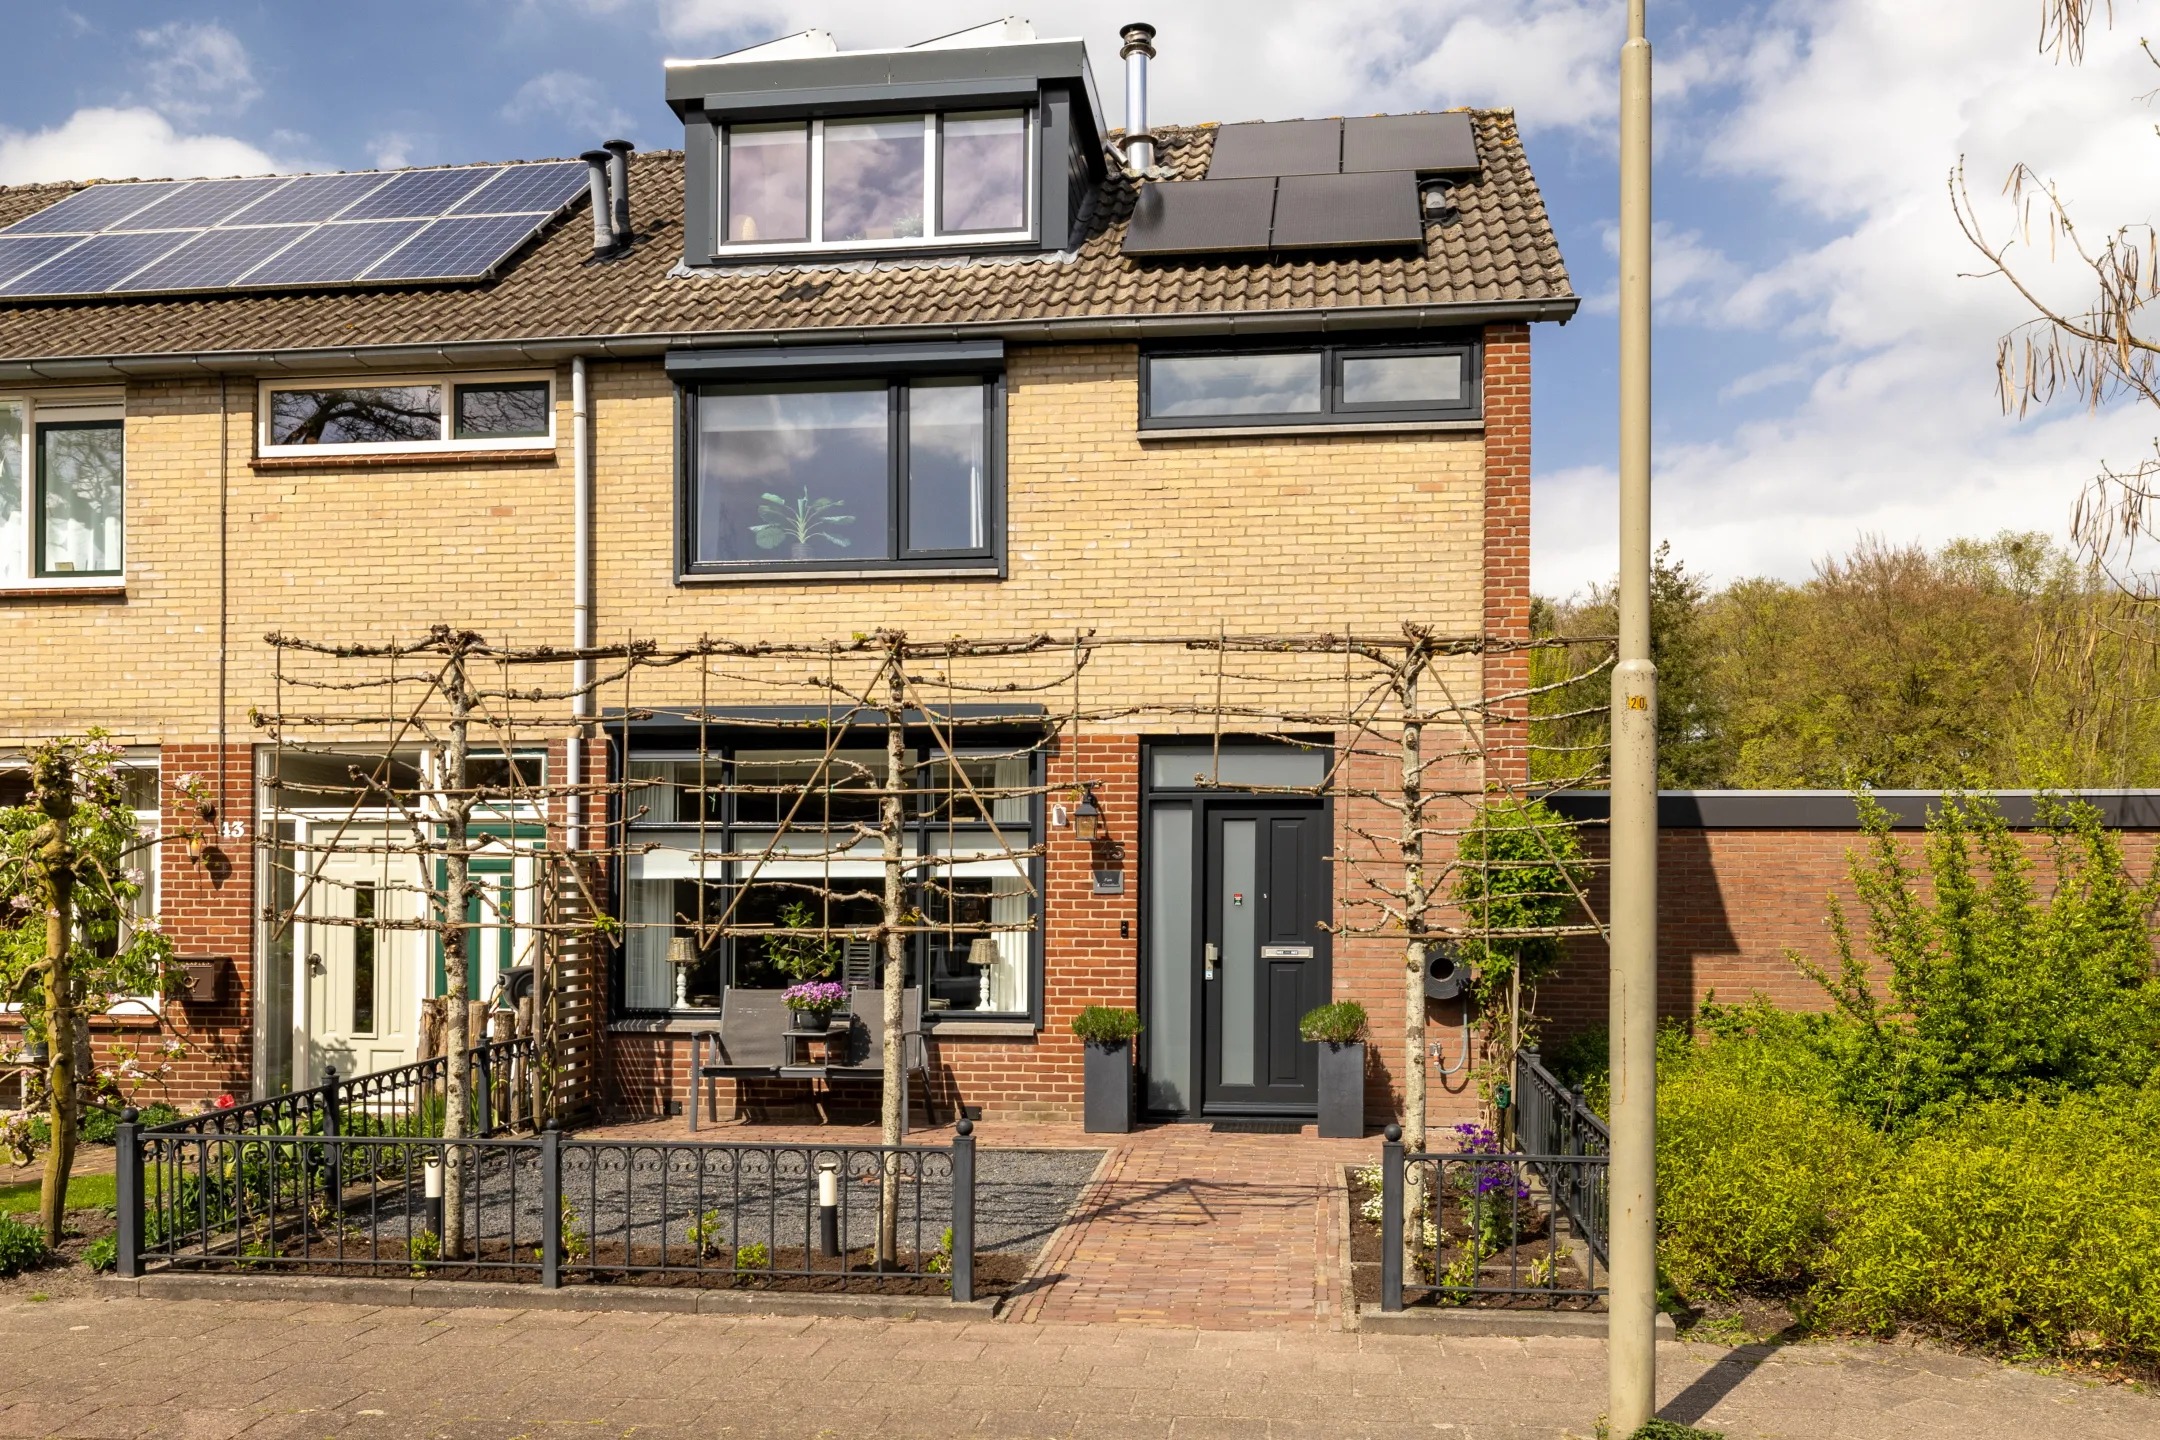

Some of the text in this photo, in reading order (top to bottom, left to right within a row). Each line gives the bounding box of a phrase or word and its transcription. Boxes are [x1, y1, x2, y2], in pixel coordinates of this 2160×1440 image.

[1631, 697, 1645, 708] 20
[219, 820, 245, 838] 43
[1100, 841, 1125, 859] 45
